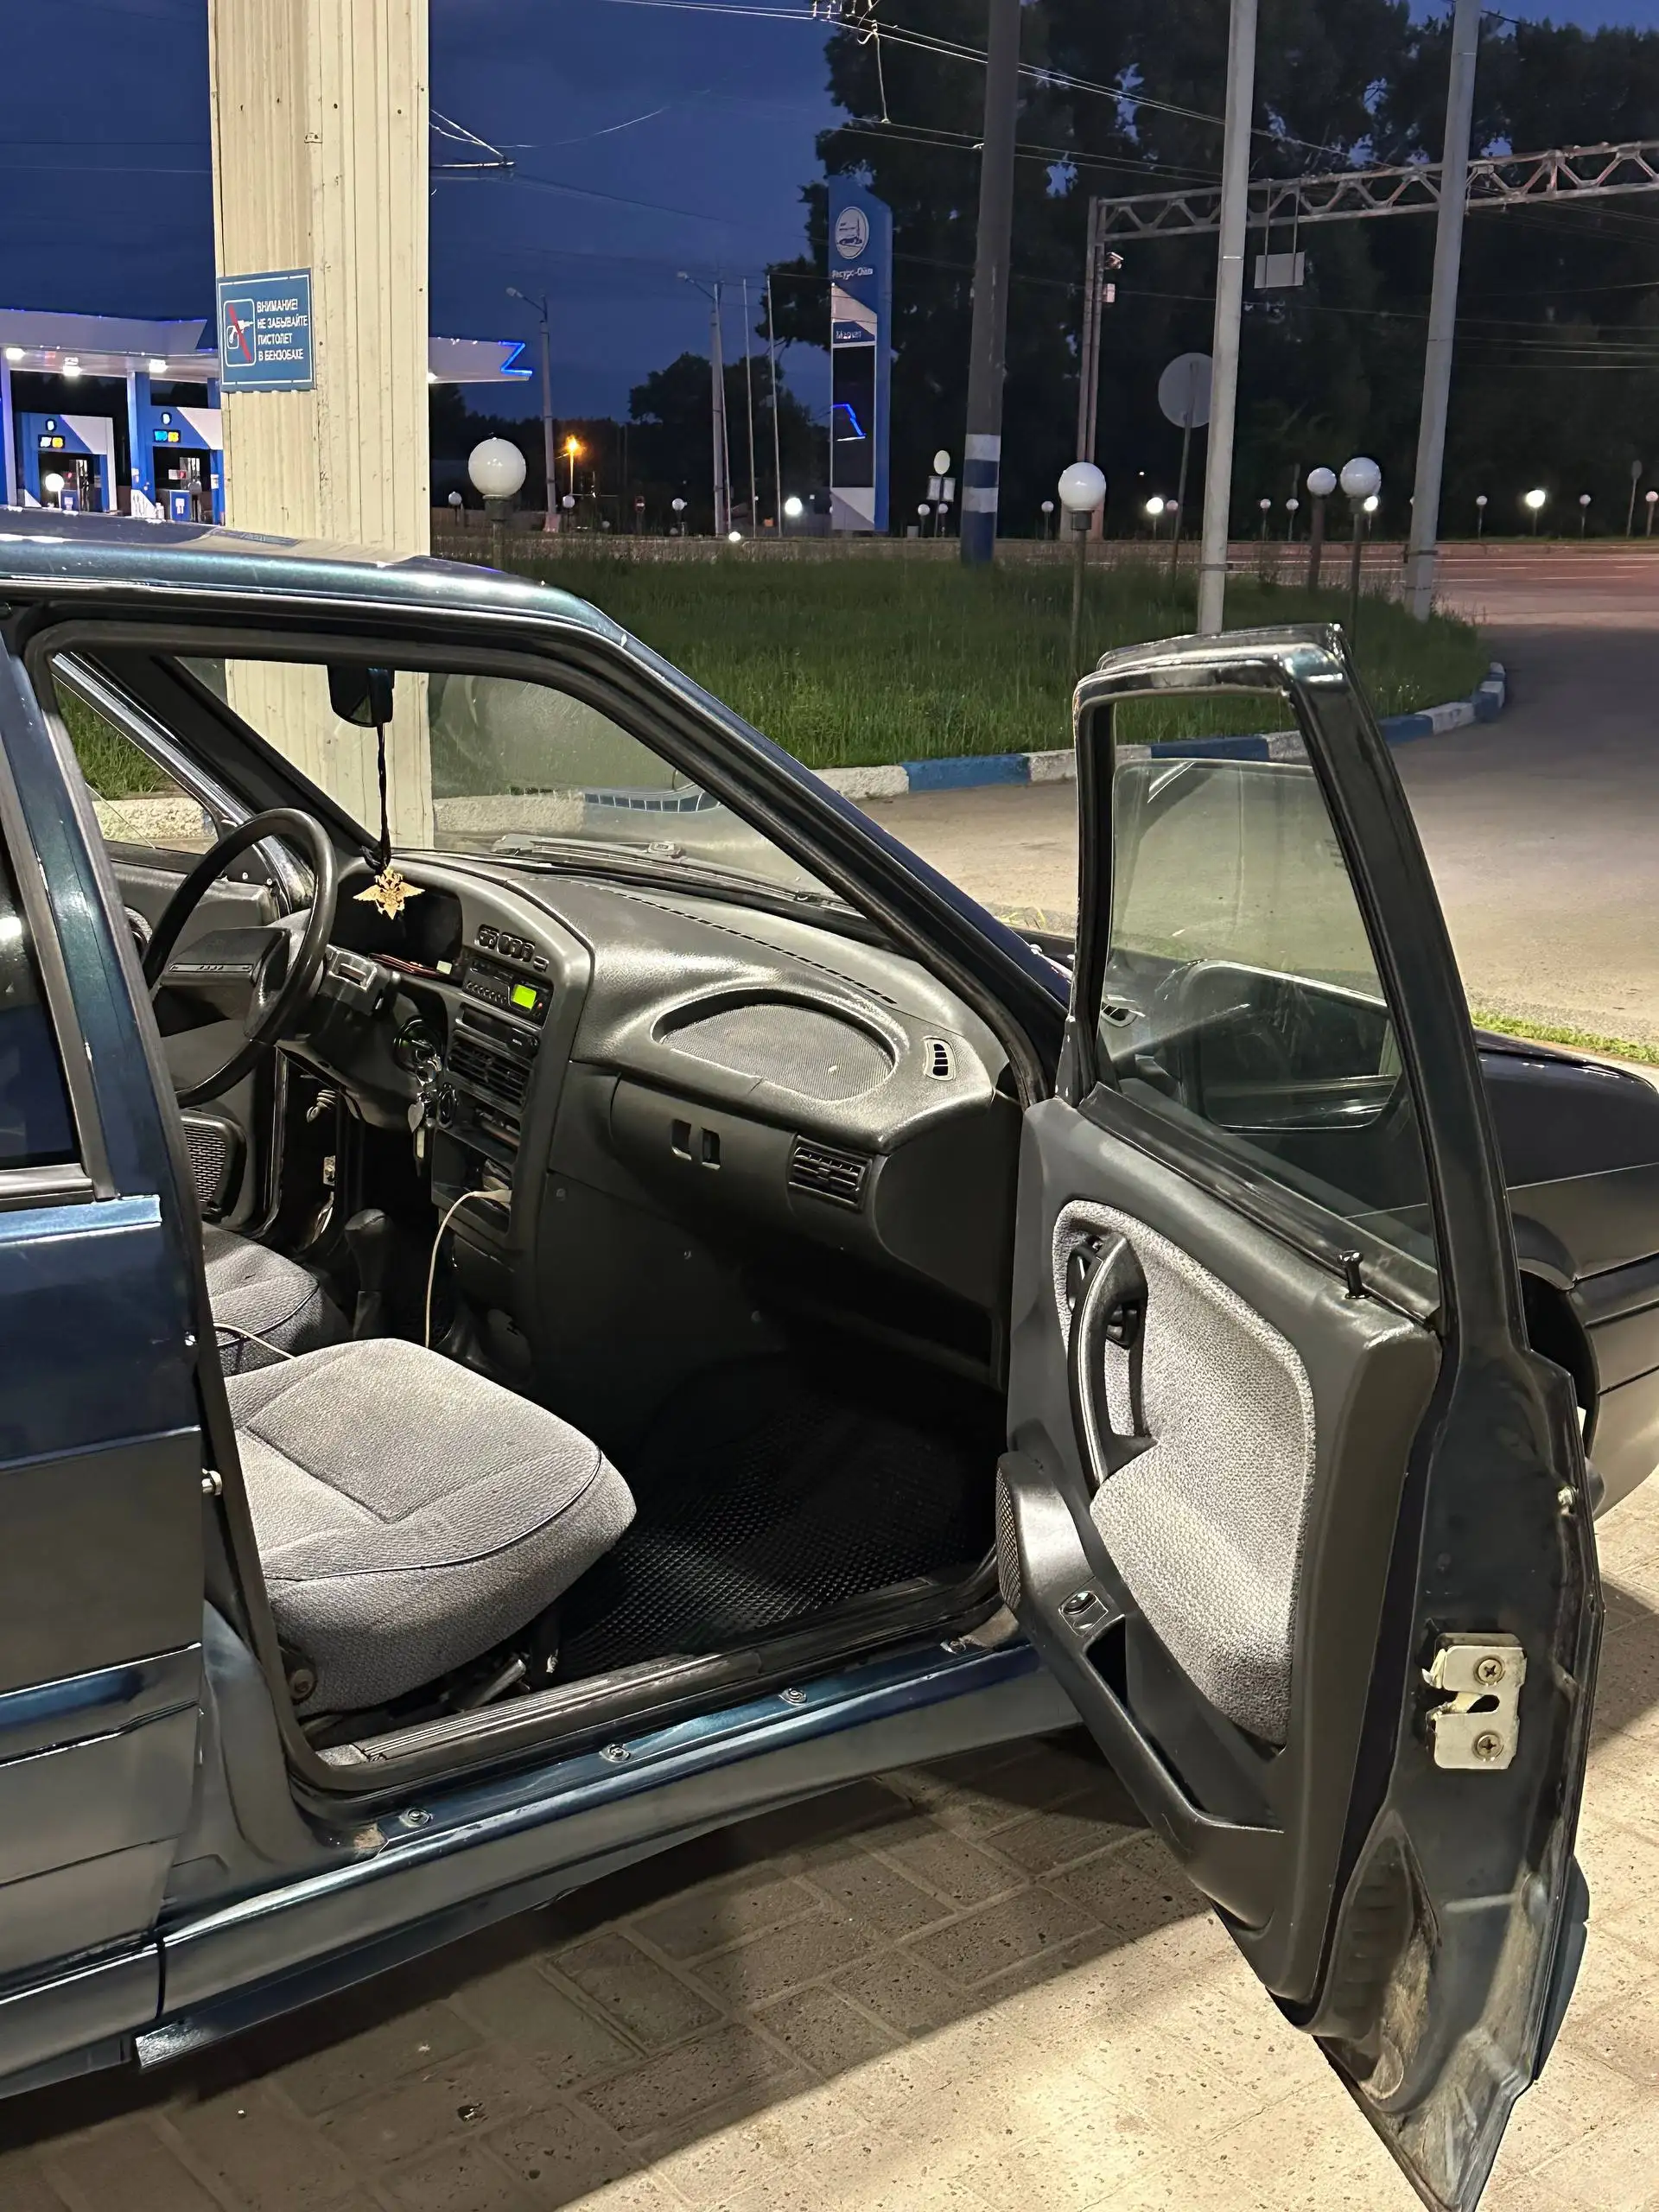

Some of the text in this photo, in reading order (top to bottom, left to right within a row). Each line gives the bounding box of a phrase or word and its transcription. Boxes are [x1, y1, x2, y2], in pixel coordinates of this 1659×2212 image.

[257, 298, 298, 313] ВНИМАНИЕ!
[257, 314, 308, 328] НЕ ЗАБЫВАЙТЕ
[257, 333, 293, 345] ПИСТОЛЕТ
[258, 348, 304, 361] В БЕНЗОБАКЕ
